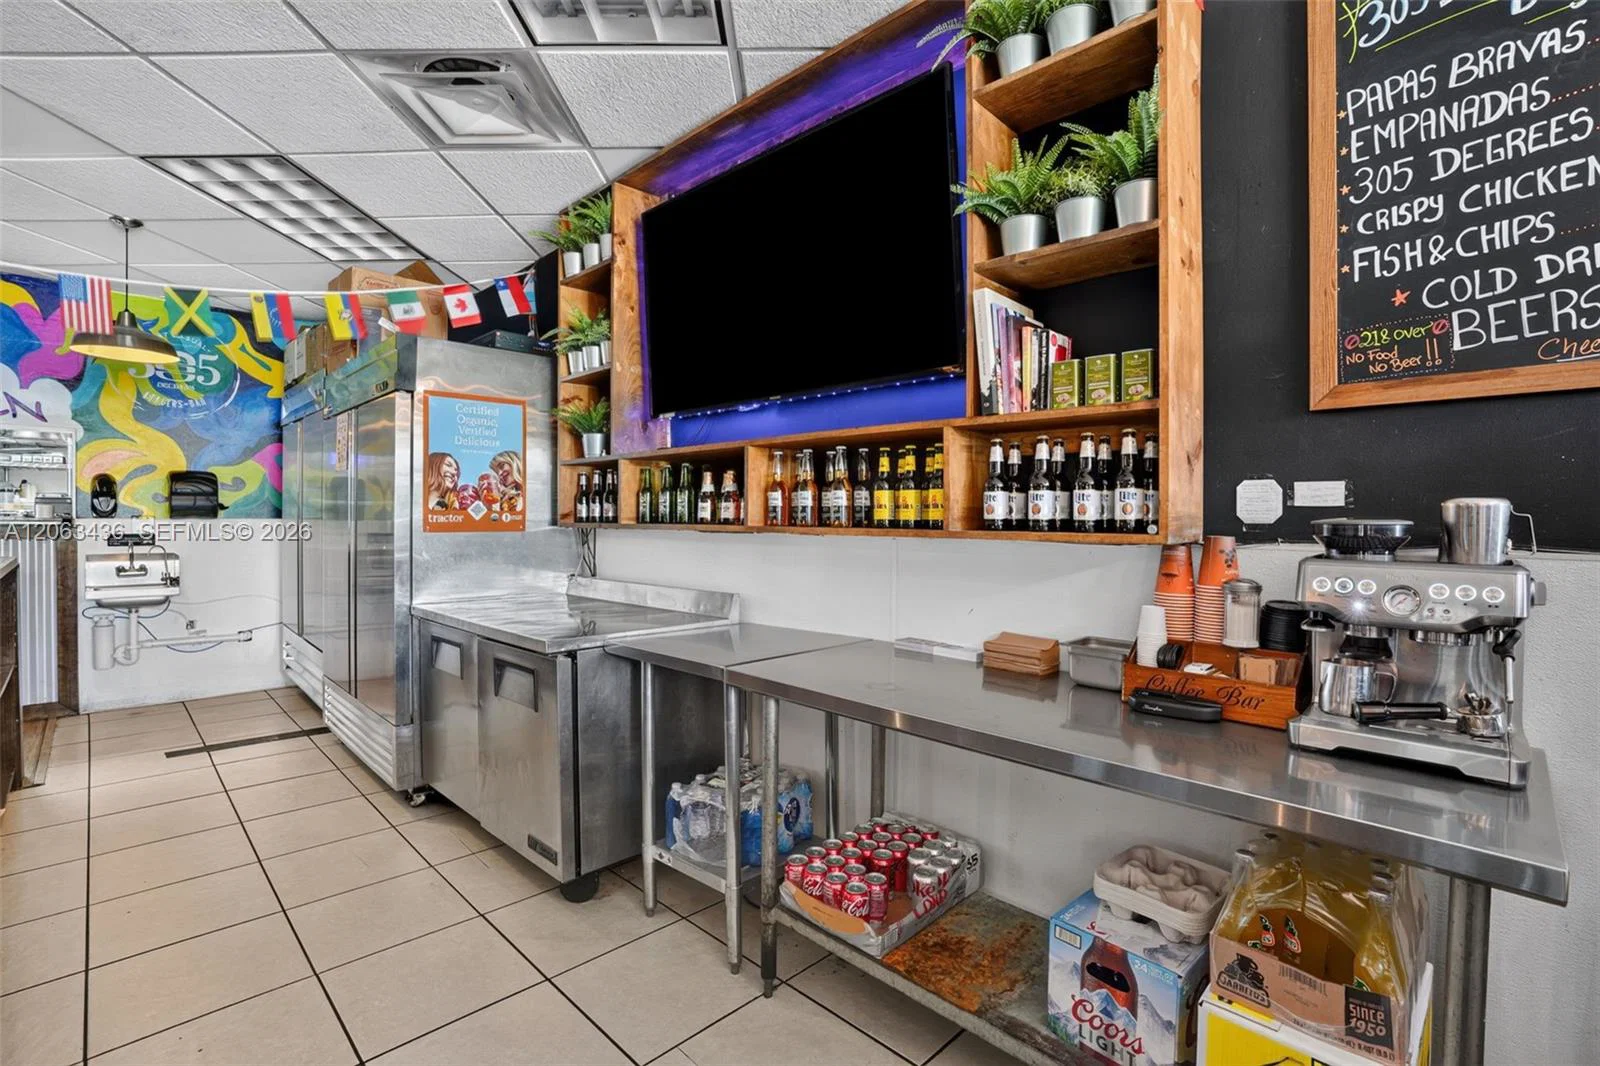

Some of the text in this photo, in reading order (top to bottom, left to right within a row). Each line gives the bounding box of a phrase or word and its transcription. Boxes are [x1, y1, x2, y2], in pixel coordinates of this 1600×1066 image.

[1346, 19, 1588, 125] PAPAS BRAVAS
[1350, 76, 1551, 164] EMPANADAS
[1349, 106, 1594, 204] 305 DEGREES
[1422, 267, 1518, 309] COLD
[1452, 284, 1600, 351] BEERS
[1368, 344, 1398, 361] Food
[1390, 355, 1422, 372] Beer
[455, 403, 500, 416] Certified
[454, 436, 500, 448] Delicious
[428, 513, 464, 523] tractor
[1216, 684, 1266, 712] Bar
[1071, 994, 1145, 1055] Coors
[1349, 1018, 1387, 1037] 1950
[1079, 1023, 1136, 1066] LIGHT
